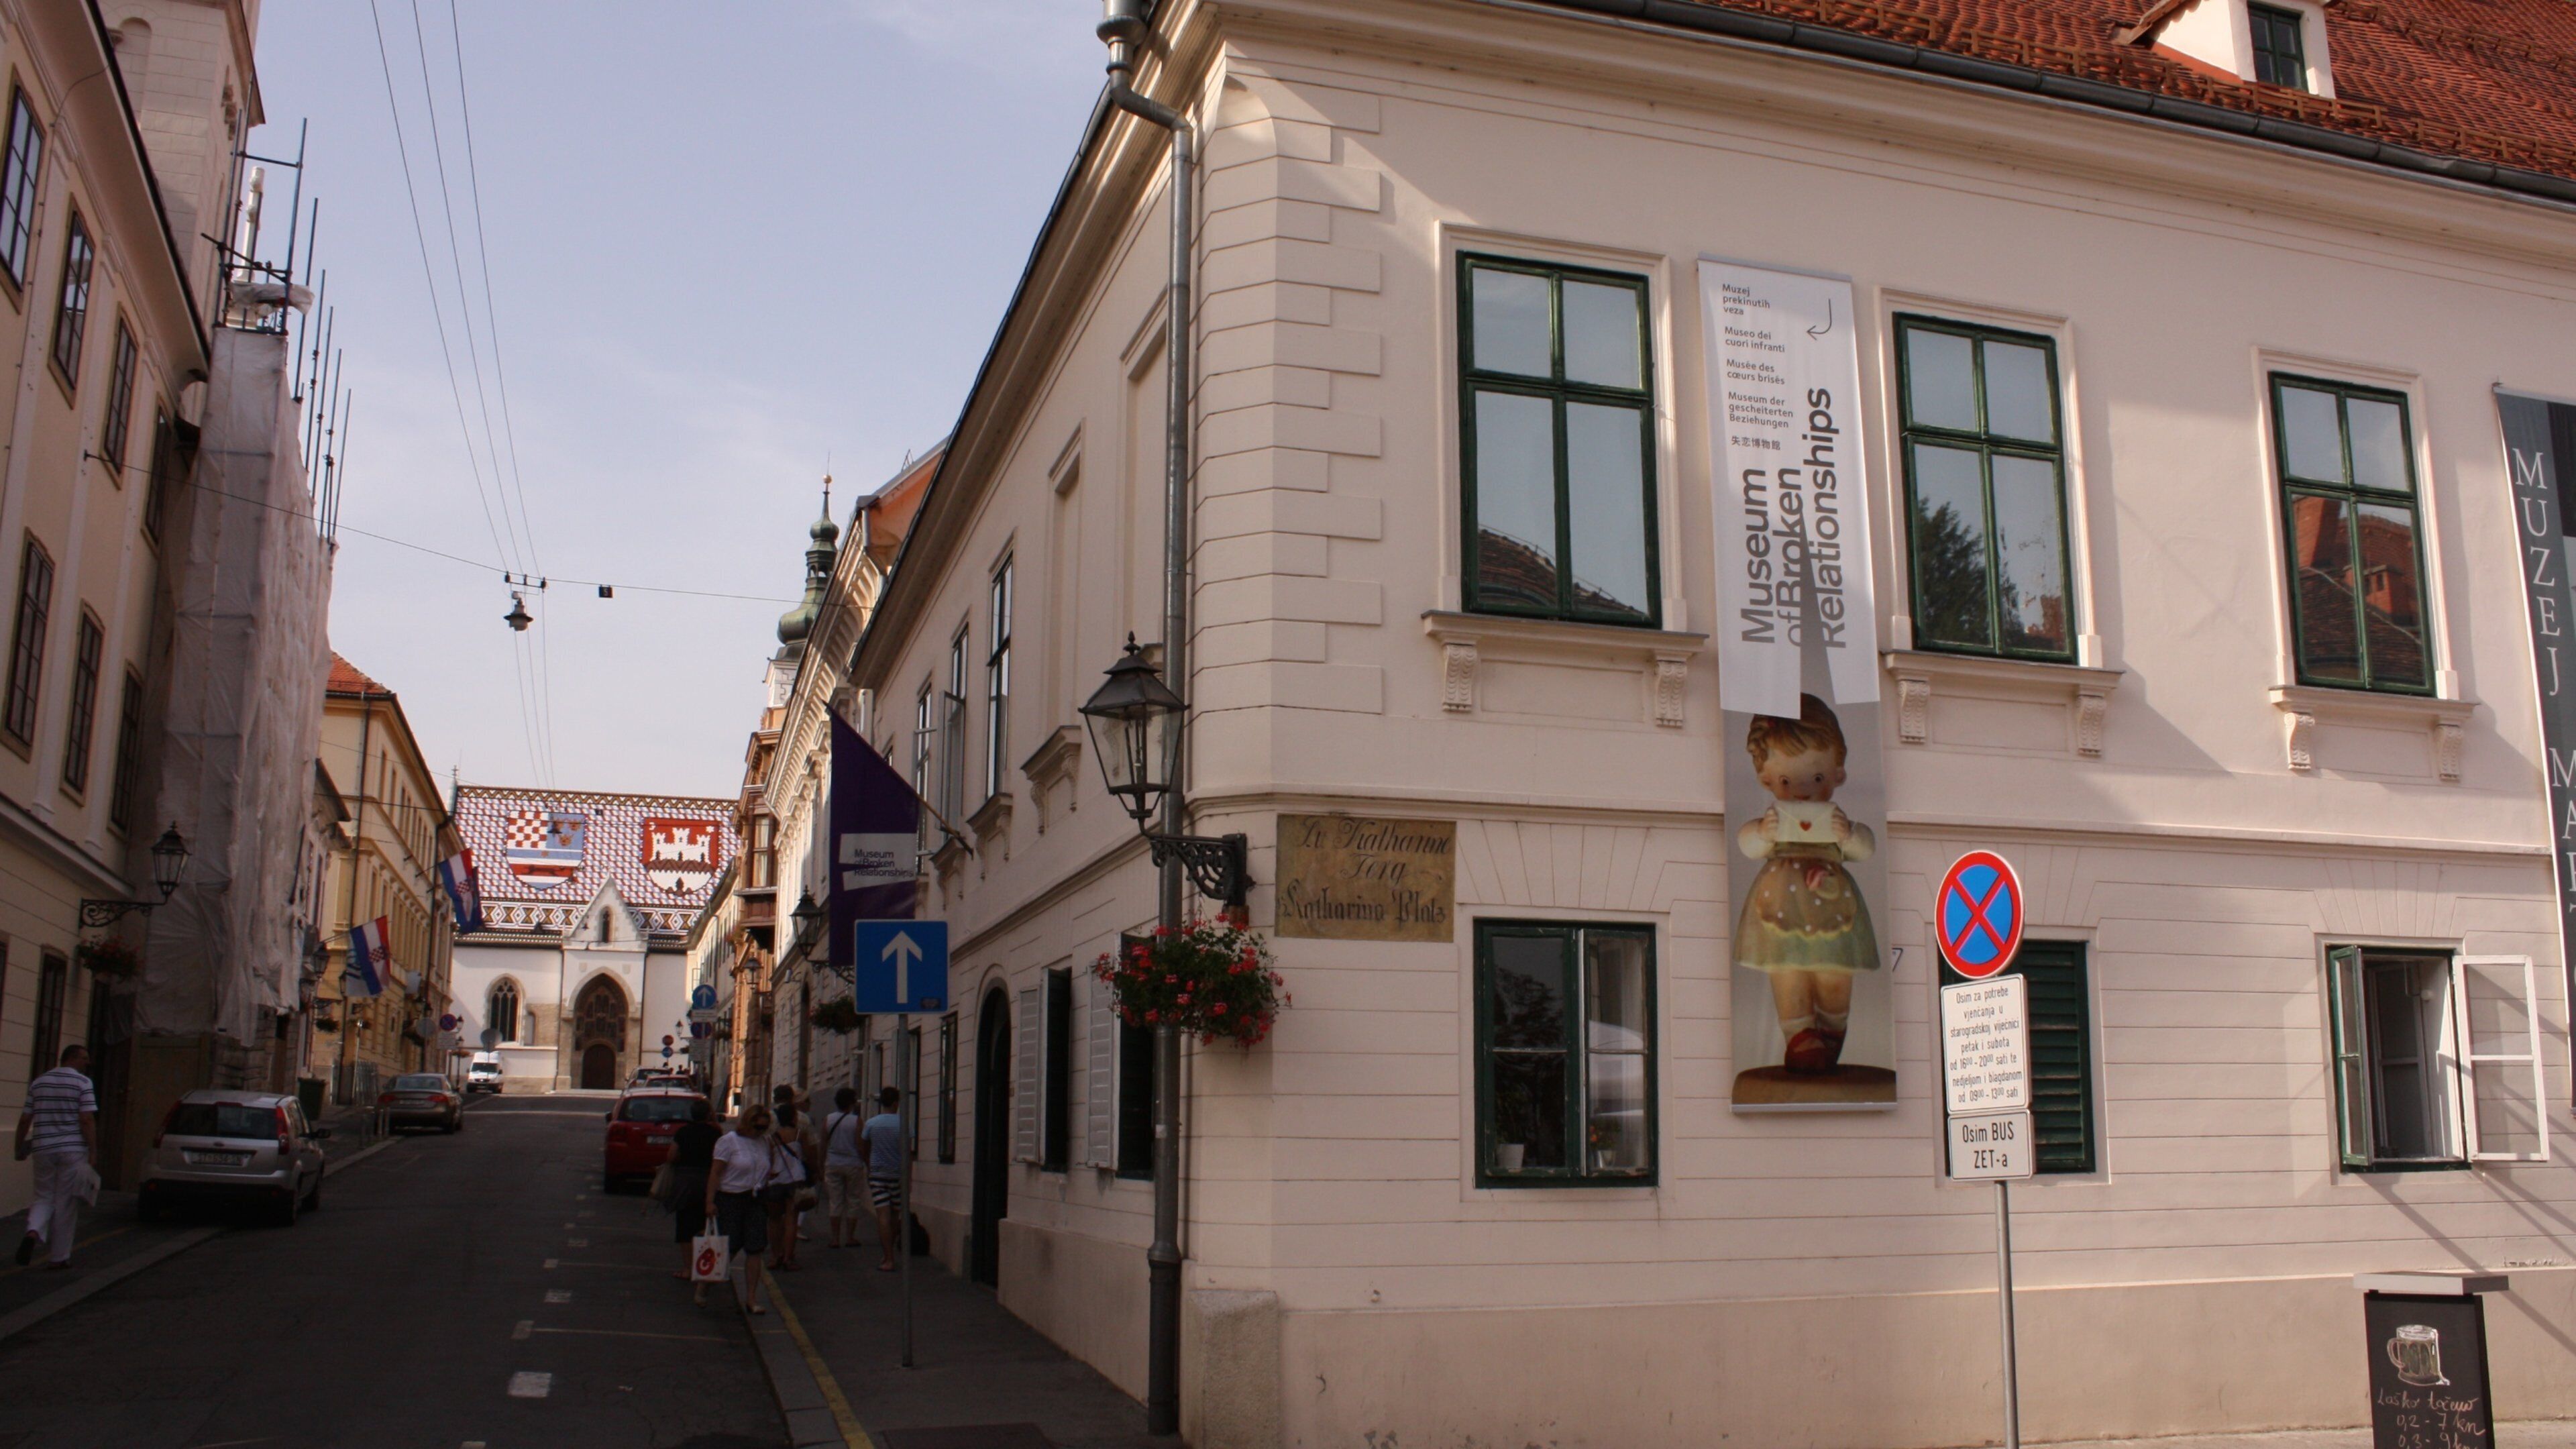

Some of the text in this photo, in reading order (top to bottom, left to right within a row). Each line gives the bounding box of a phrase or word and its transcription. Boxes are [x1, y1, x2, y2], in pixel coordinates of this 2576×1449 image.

[1722, 283, 1750, 297] Muzej
[1723, 294, 1770, 309] prekinutih
[1723, 306, 1744, 315] veza
[1725, 326, 1772, 341] Museo dei
[1725, 337, 1785, 353] cuori infranti
[1727, 358, 1774, 372] Musée des
[1727, 371, 1785, 385] cœurs brisés
[1728, 391, 1785, 406] Museum der
[1729, 403, 1794, 418] gescheiterten
[1729, 414, 1789, 429] Beziehungen
[1803, 387, 1847, 649] Relationships
[1772, 468, 1805, 607] Broken
[1740, 469, 1776, 644] Museum
[2512, 447, 2561, 696] MUZEJ
[854, 849, 894, 859] Museum
[863, 859, 895, 868] Broken
[854, 867, 914, 877] Relationships
[1956, 986, 2008, 1004] Osim za potrebe
[1999, 1006, 2003, 1014] u
[1951, 1022, 1990, 1038] starogradskoj
[1961, 1038, 2010, 1055] petak i subota
[1949, 1059, 1957, 1071] od
[1996, 1053, 2008, 1065] sati
[2010, 1053, 2017, 1063] te
[1952, 1073, 1982, 1088] nedjeljom
[1988, 1070, 2023, 1085] blagdanom
[1958, 1091, 1966, 1103] od
[2006, 1086, 2018, 1098] sati
[1962, 1121, 2015, 1143] Osim BUS
[1974, 1149, 2008, 1169] ZET-a
[2396, 1414, 2420, 1432] 0,2
[2436, 1411, 2447, 1430] 7
[2453, 1411, 2485, 1436] kn
